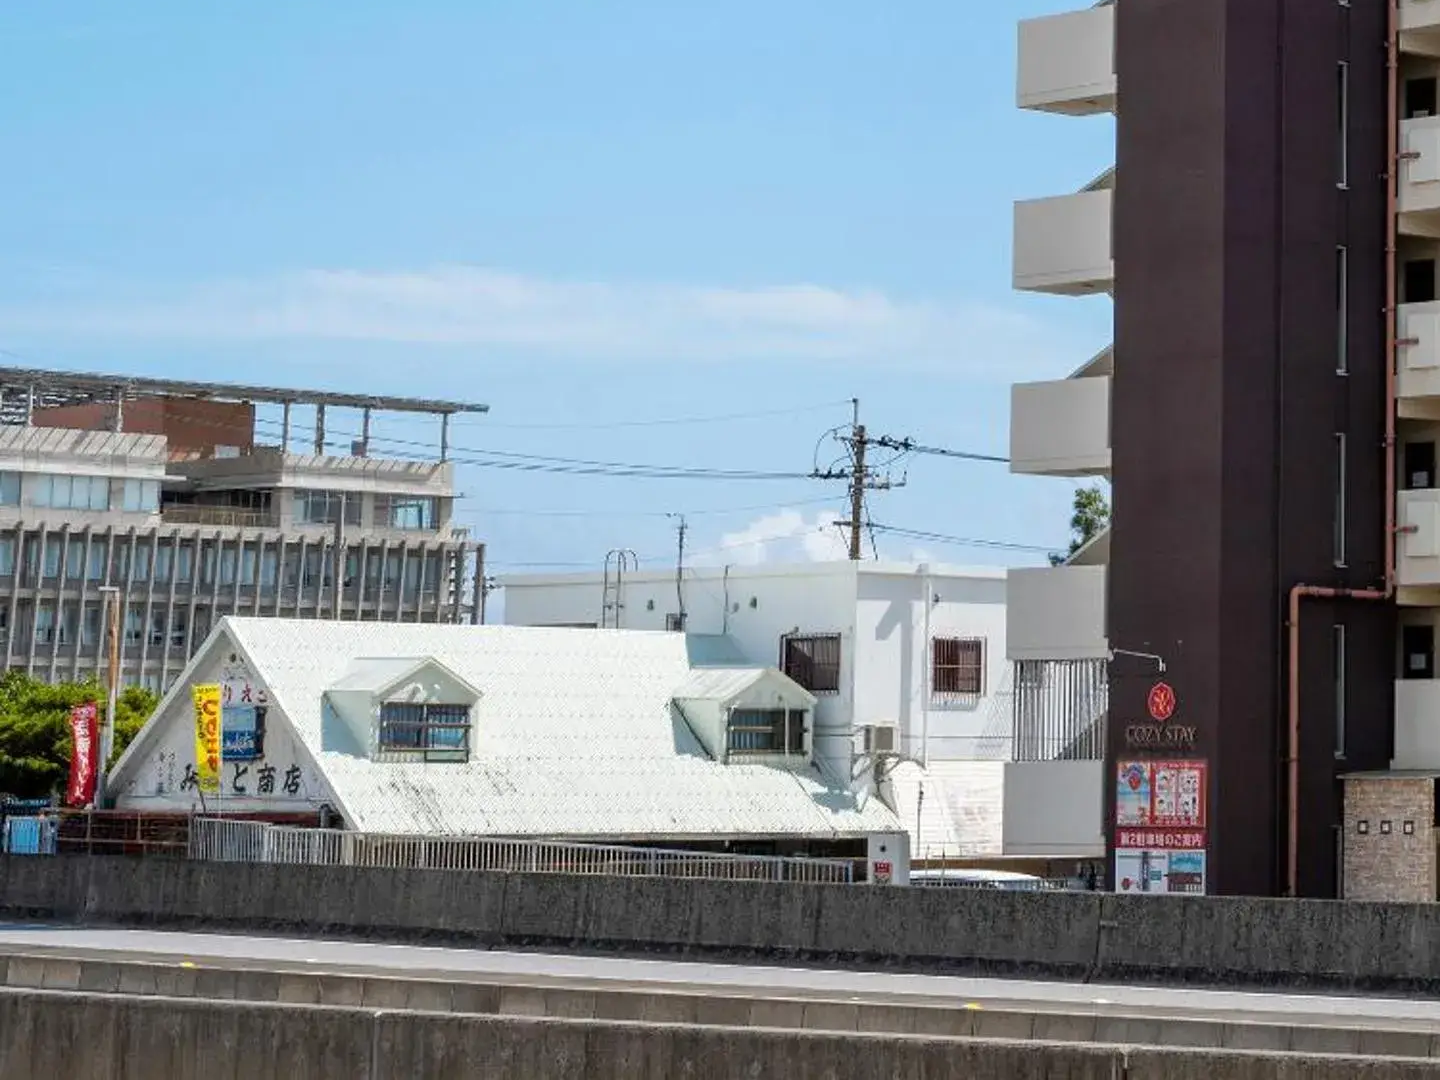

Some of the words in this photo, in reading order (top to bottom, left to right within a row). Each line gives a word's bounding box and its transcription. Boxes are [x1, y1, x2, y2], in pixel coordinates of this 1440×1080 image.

[1125, 725, 1163, 743] COZY
[1165, 725, 1197, 743] STAY
[180, 763, 304, 794] みと商店
